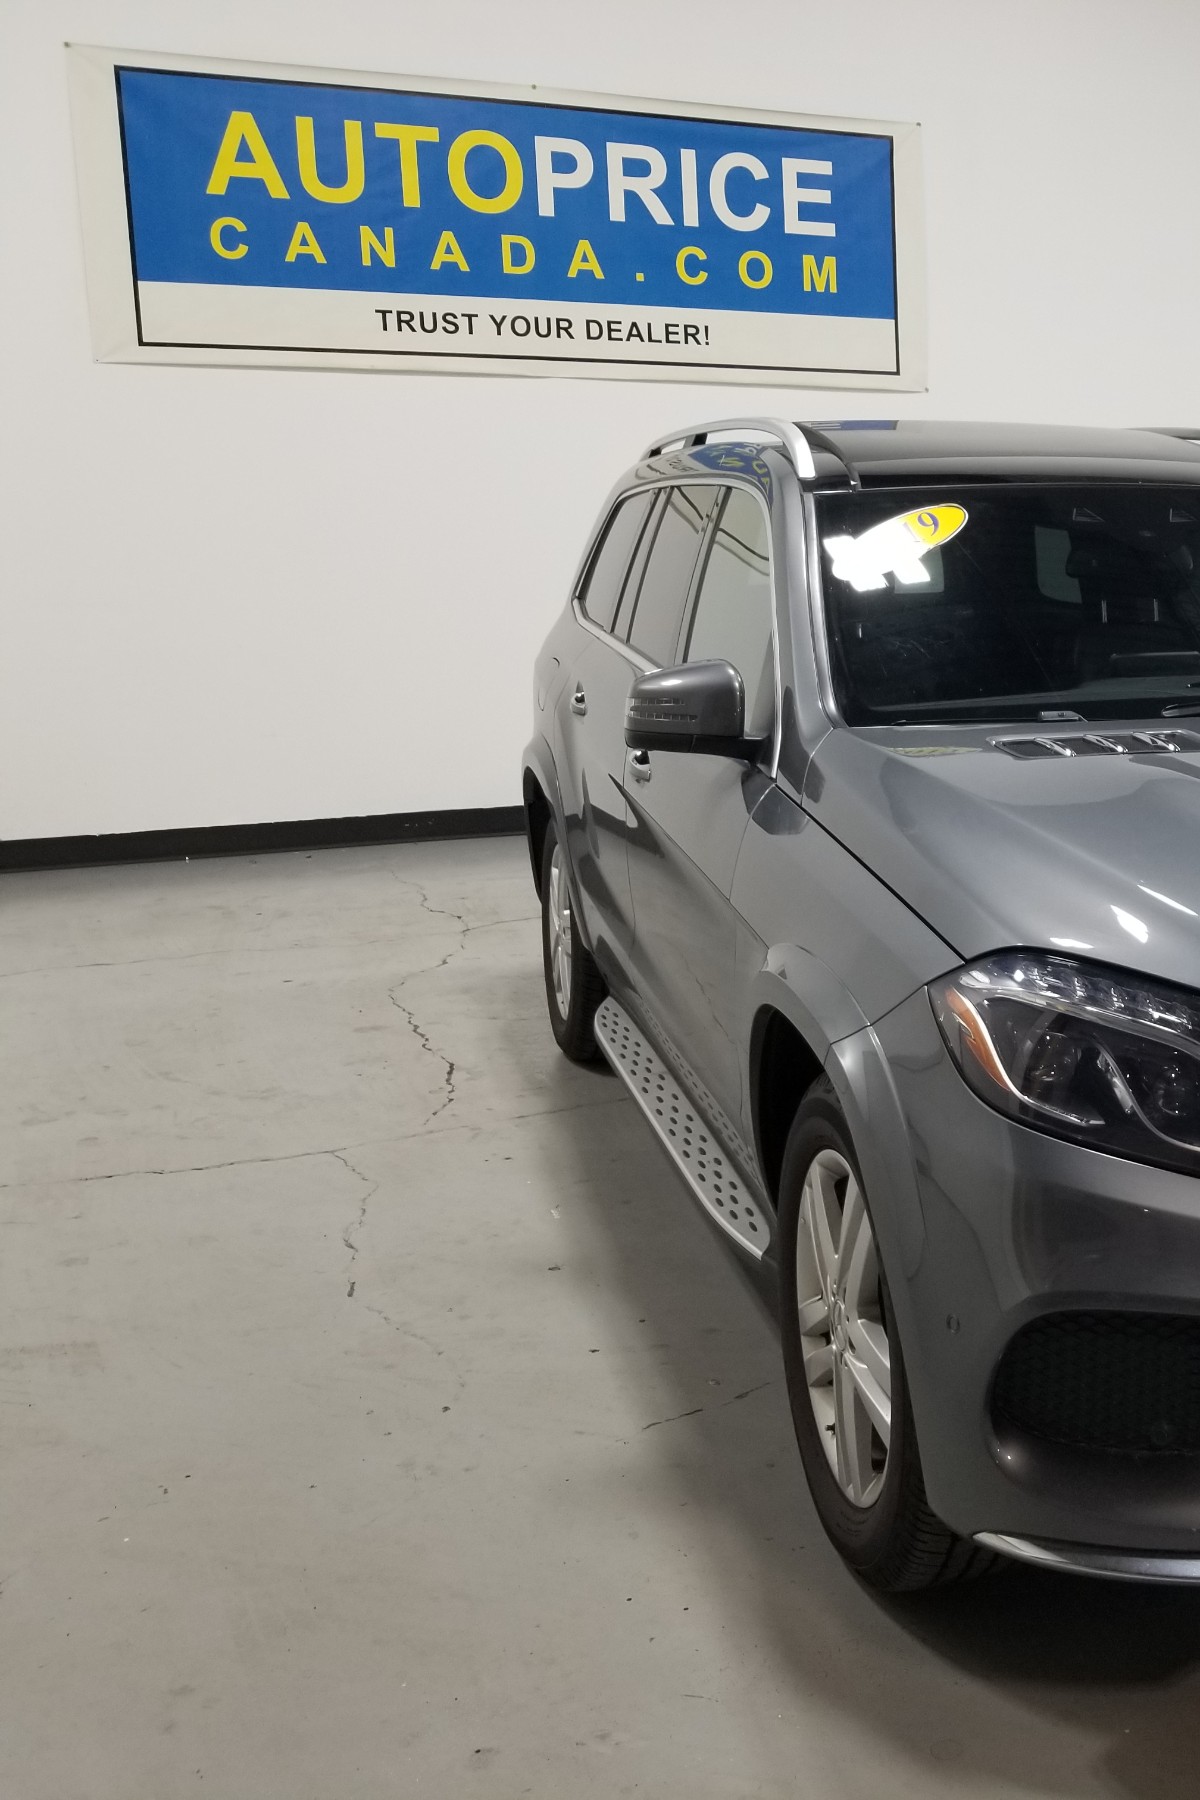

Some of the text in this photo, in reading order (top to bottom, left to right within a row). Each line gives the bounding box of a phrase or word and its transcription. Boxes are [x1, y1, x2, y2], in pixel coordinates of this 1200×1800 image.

[206, 110, 836, 238] AUTOPRICE
[210, 216, 838, 294] CANADA.COM
[374, 308, 711, 346] TRUST YOUR DEALER!
